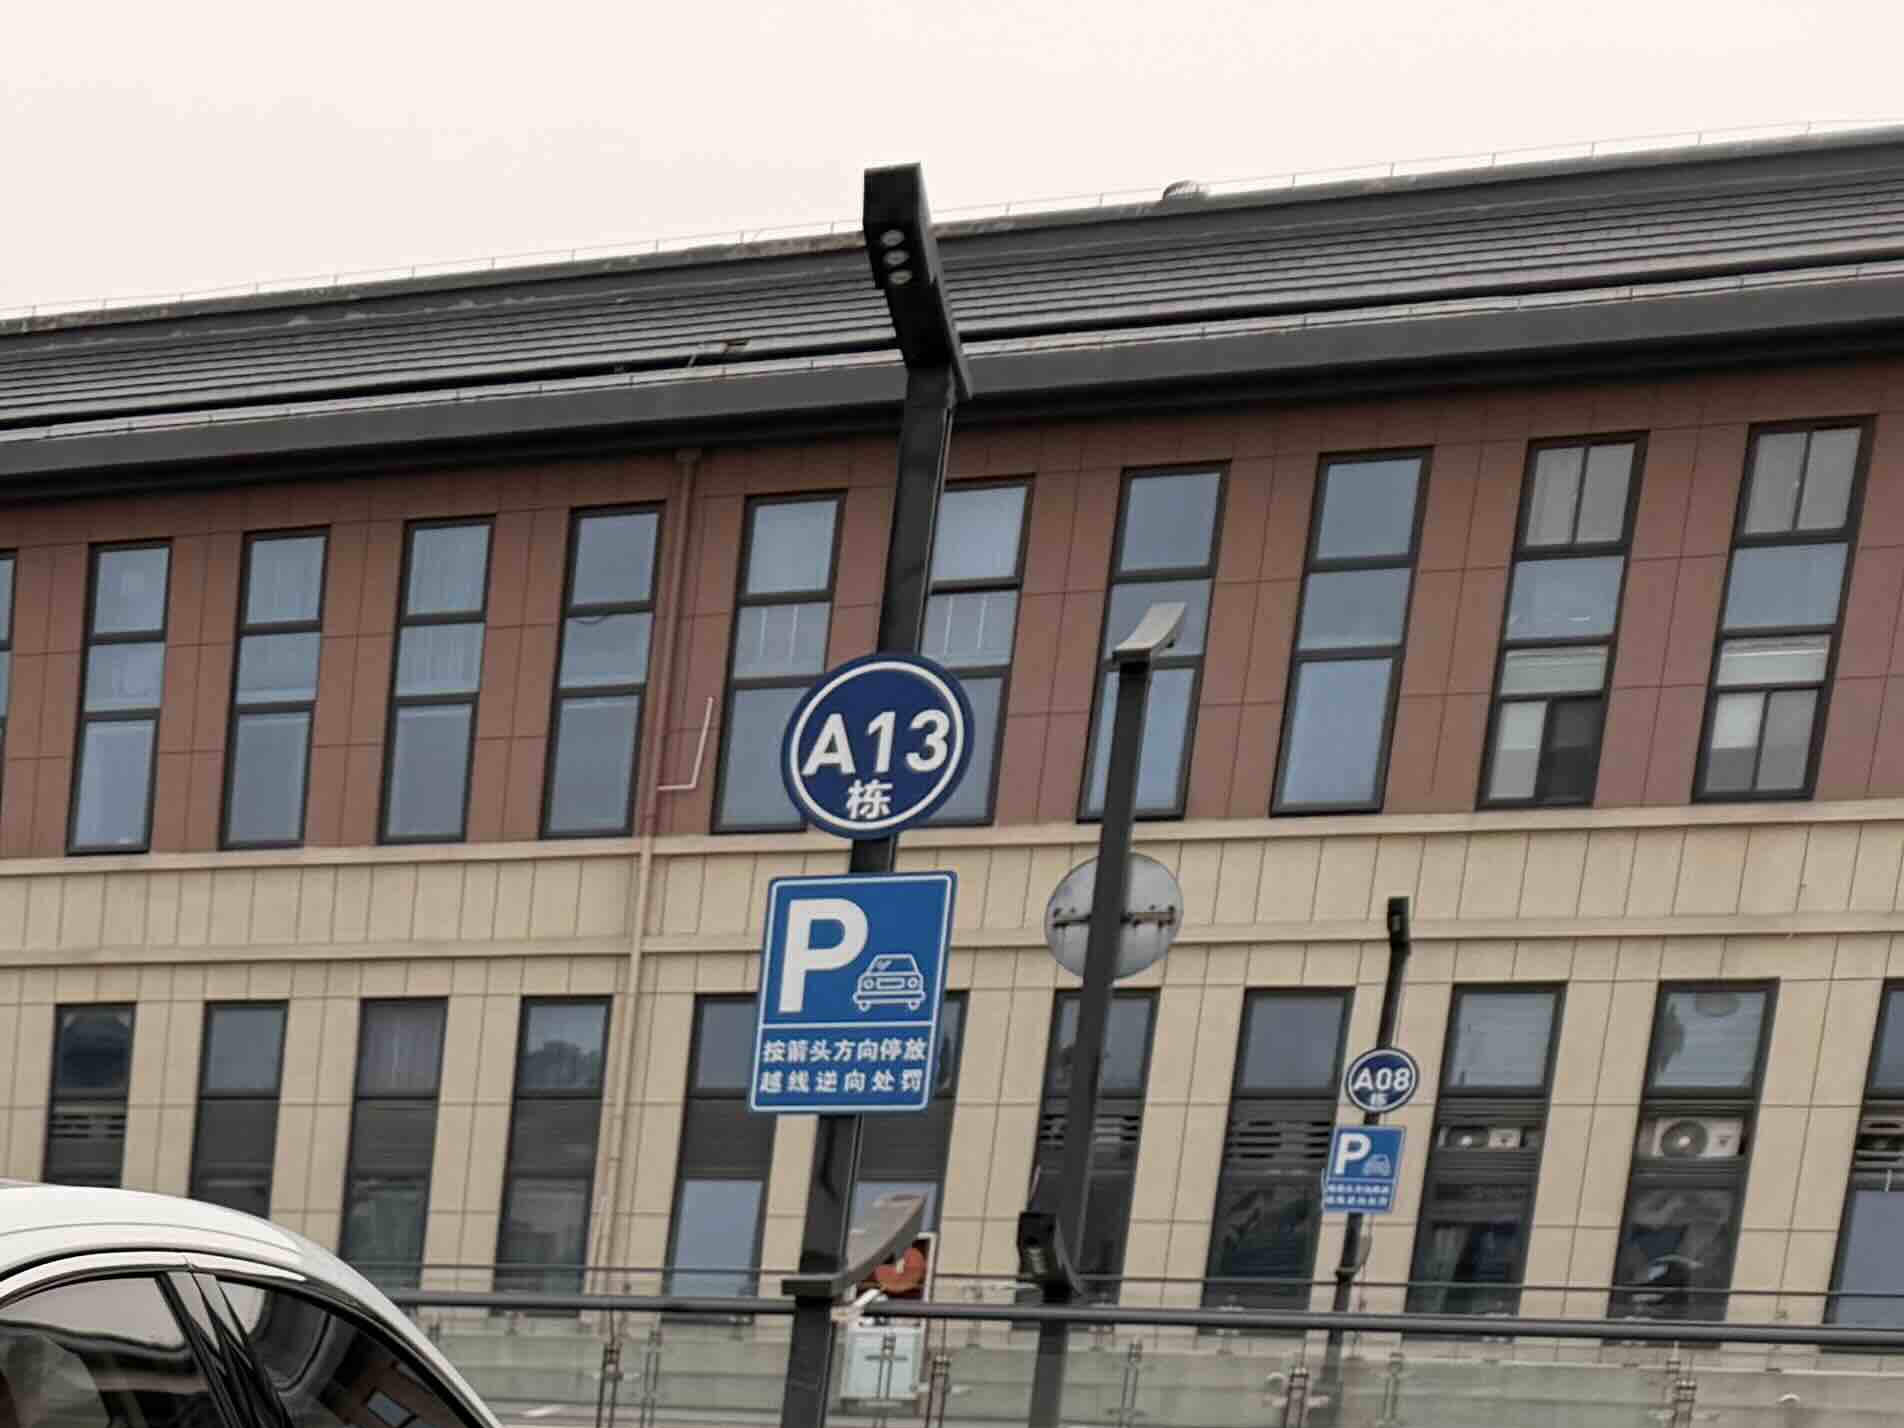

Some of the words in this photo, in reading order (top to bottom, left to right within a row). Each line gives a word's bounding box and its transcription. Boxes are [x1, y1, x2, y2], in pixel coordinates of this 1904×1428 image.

[802, 709, 951, 777] A13
[845, 779, 892, 820] 栋
[777, 897, 869, 1014] P
[762, 1037, 928, 1063] 按箭头方向停放
[759, 1068, 925, 1093] 越线逆向处罚
[1352, 1066, 1411, 1092] A08
[1334, 1132, 1372, 1175] P
